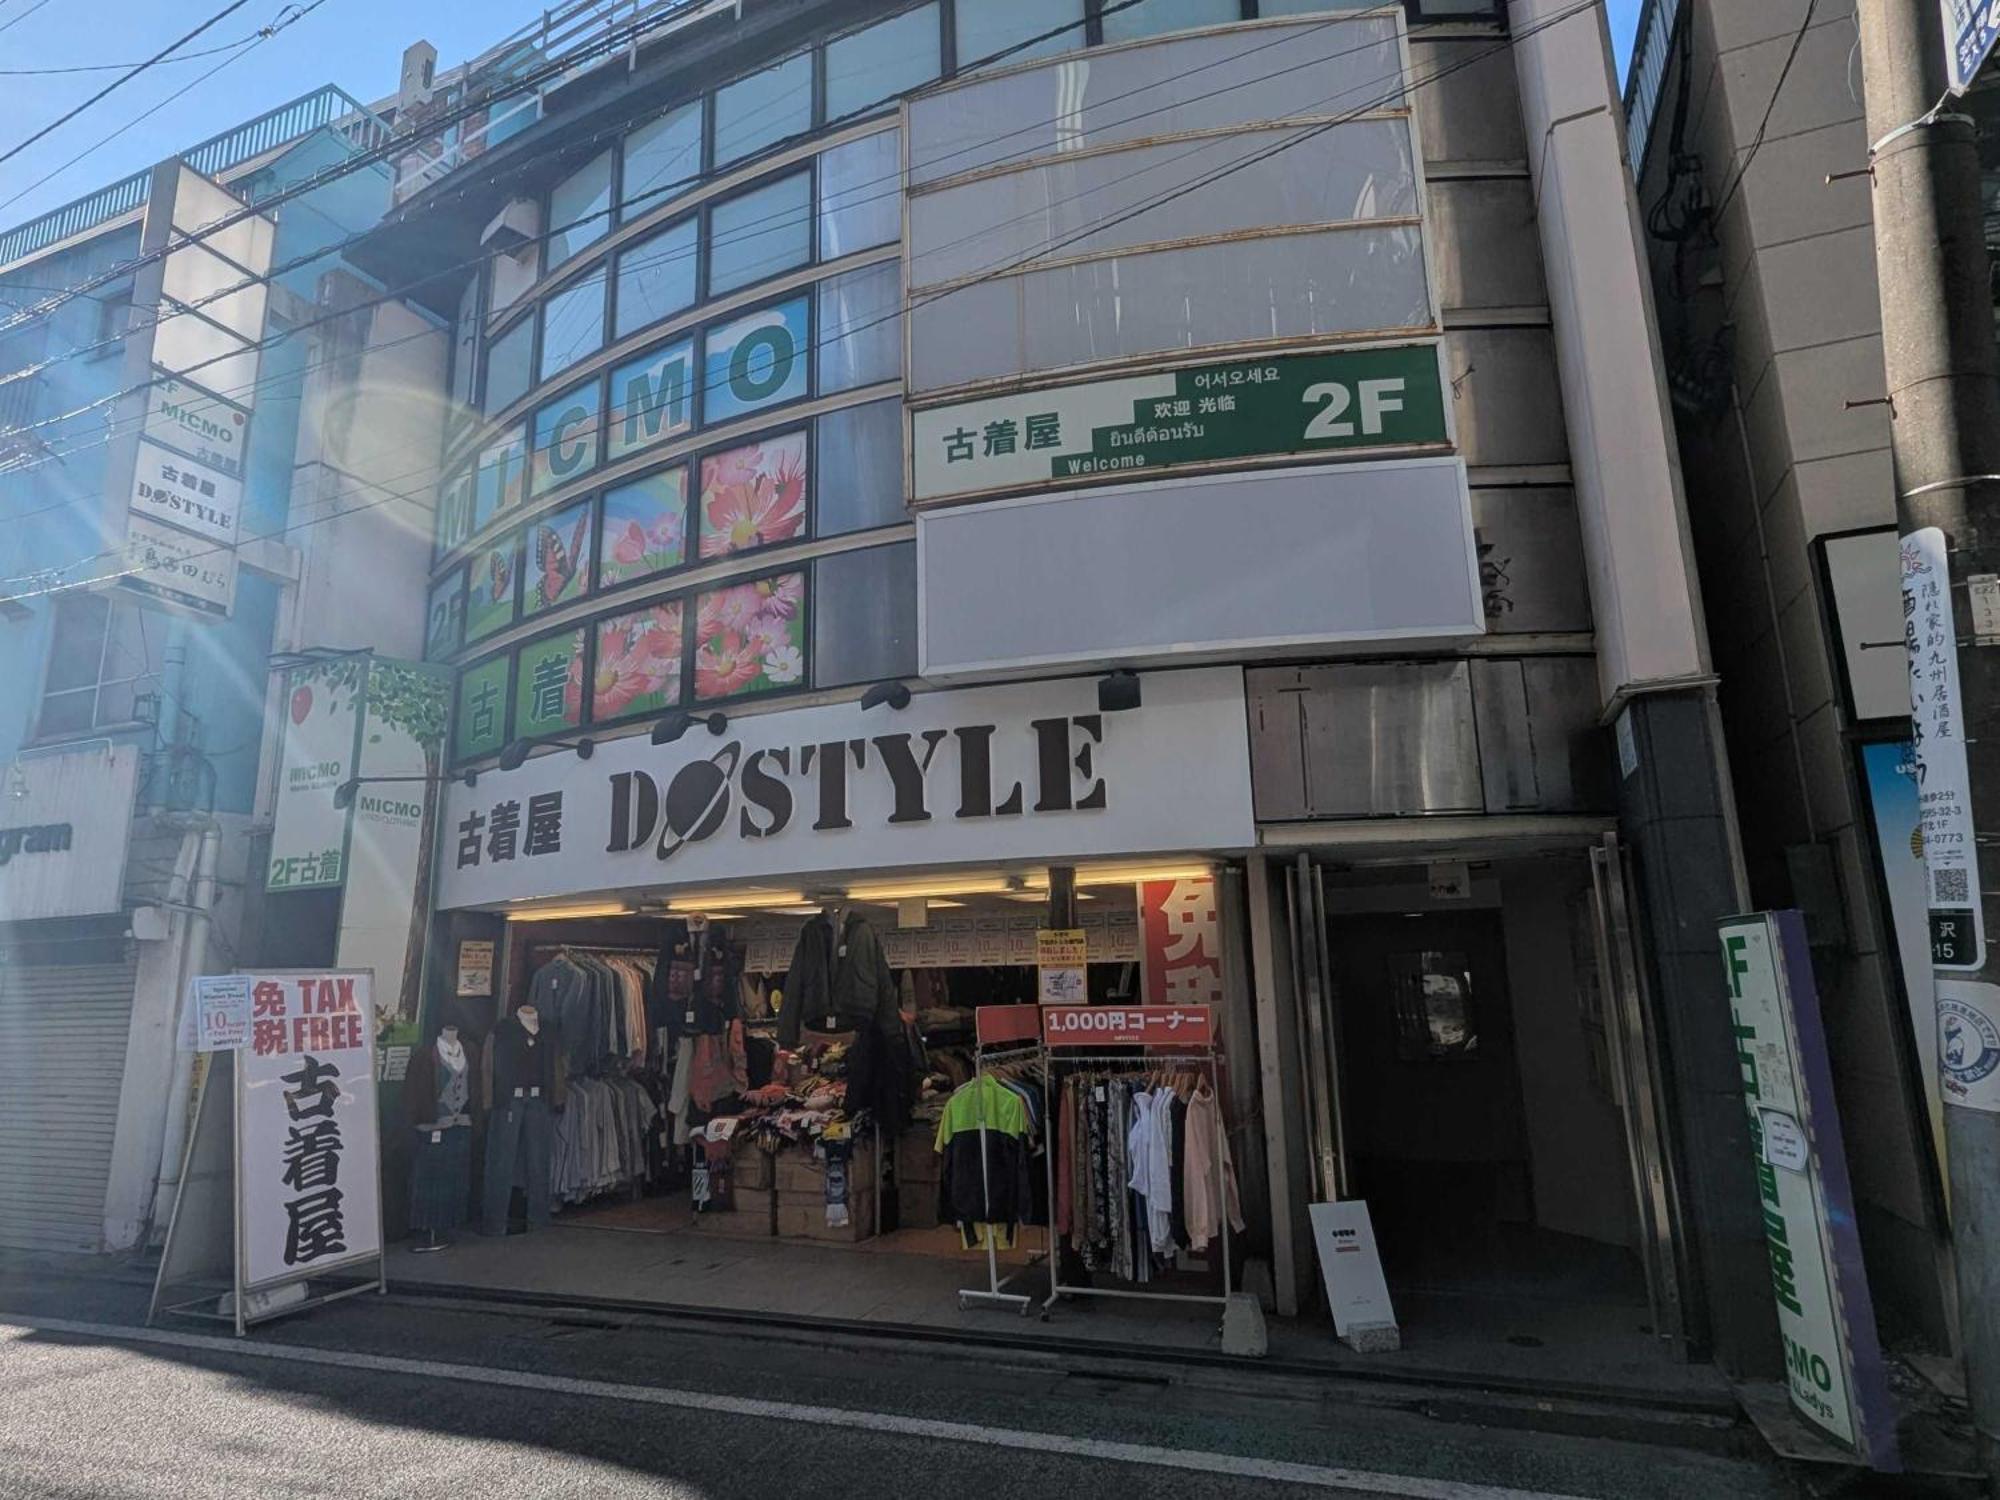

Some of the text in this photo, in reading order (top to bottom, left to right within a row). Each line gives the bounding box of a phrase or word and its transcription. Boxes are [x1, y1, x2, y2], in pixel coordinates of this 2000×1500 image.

[1195, 367, 1280, 390] 어서오세요
[160, 401, 233, 443] MICMO
[1154, 394, 1236, 419] 欢迎 光临
[1302, 377, 1405, 440] 2F
[943, 411, 1063, 464] 古着屋
[162, 464, 216, 498] 古着屋
[1068, 453, 1145, 473] Welcome
[470, 653, 570, 744] 古着
[289, 761, 341, 783] MICMO
[360, 796, 422, 818] MICMO
[456, 790, 564, 870] 古着屋
[271, 850, 341, 886] 2F古着
[1724, 935, 1749, 998] F
[297, 978, 357, 1015] TAX
[204, 1011, 227, 1030] 10
[252, 980, 288, 1056] 免税
[292, 1014, 363, 1052] FREE
[1048, 1011, 1206, 1034] 1,000円コーナー
[280, 1054, 348, 1266] 古着屋
